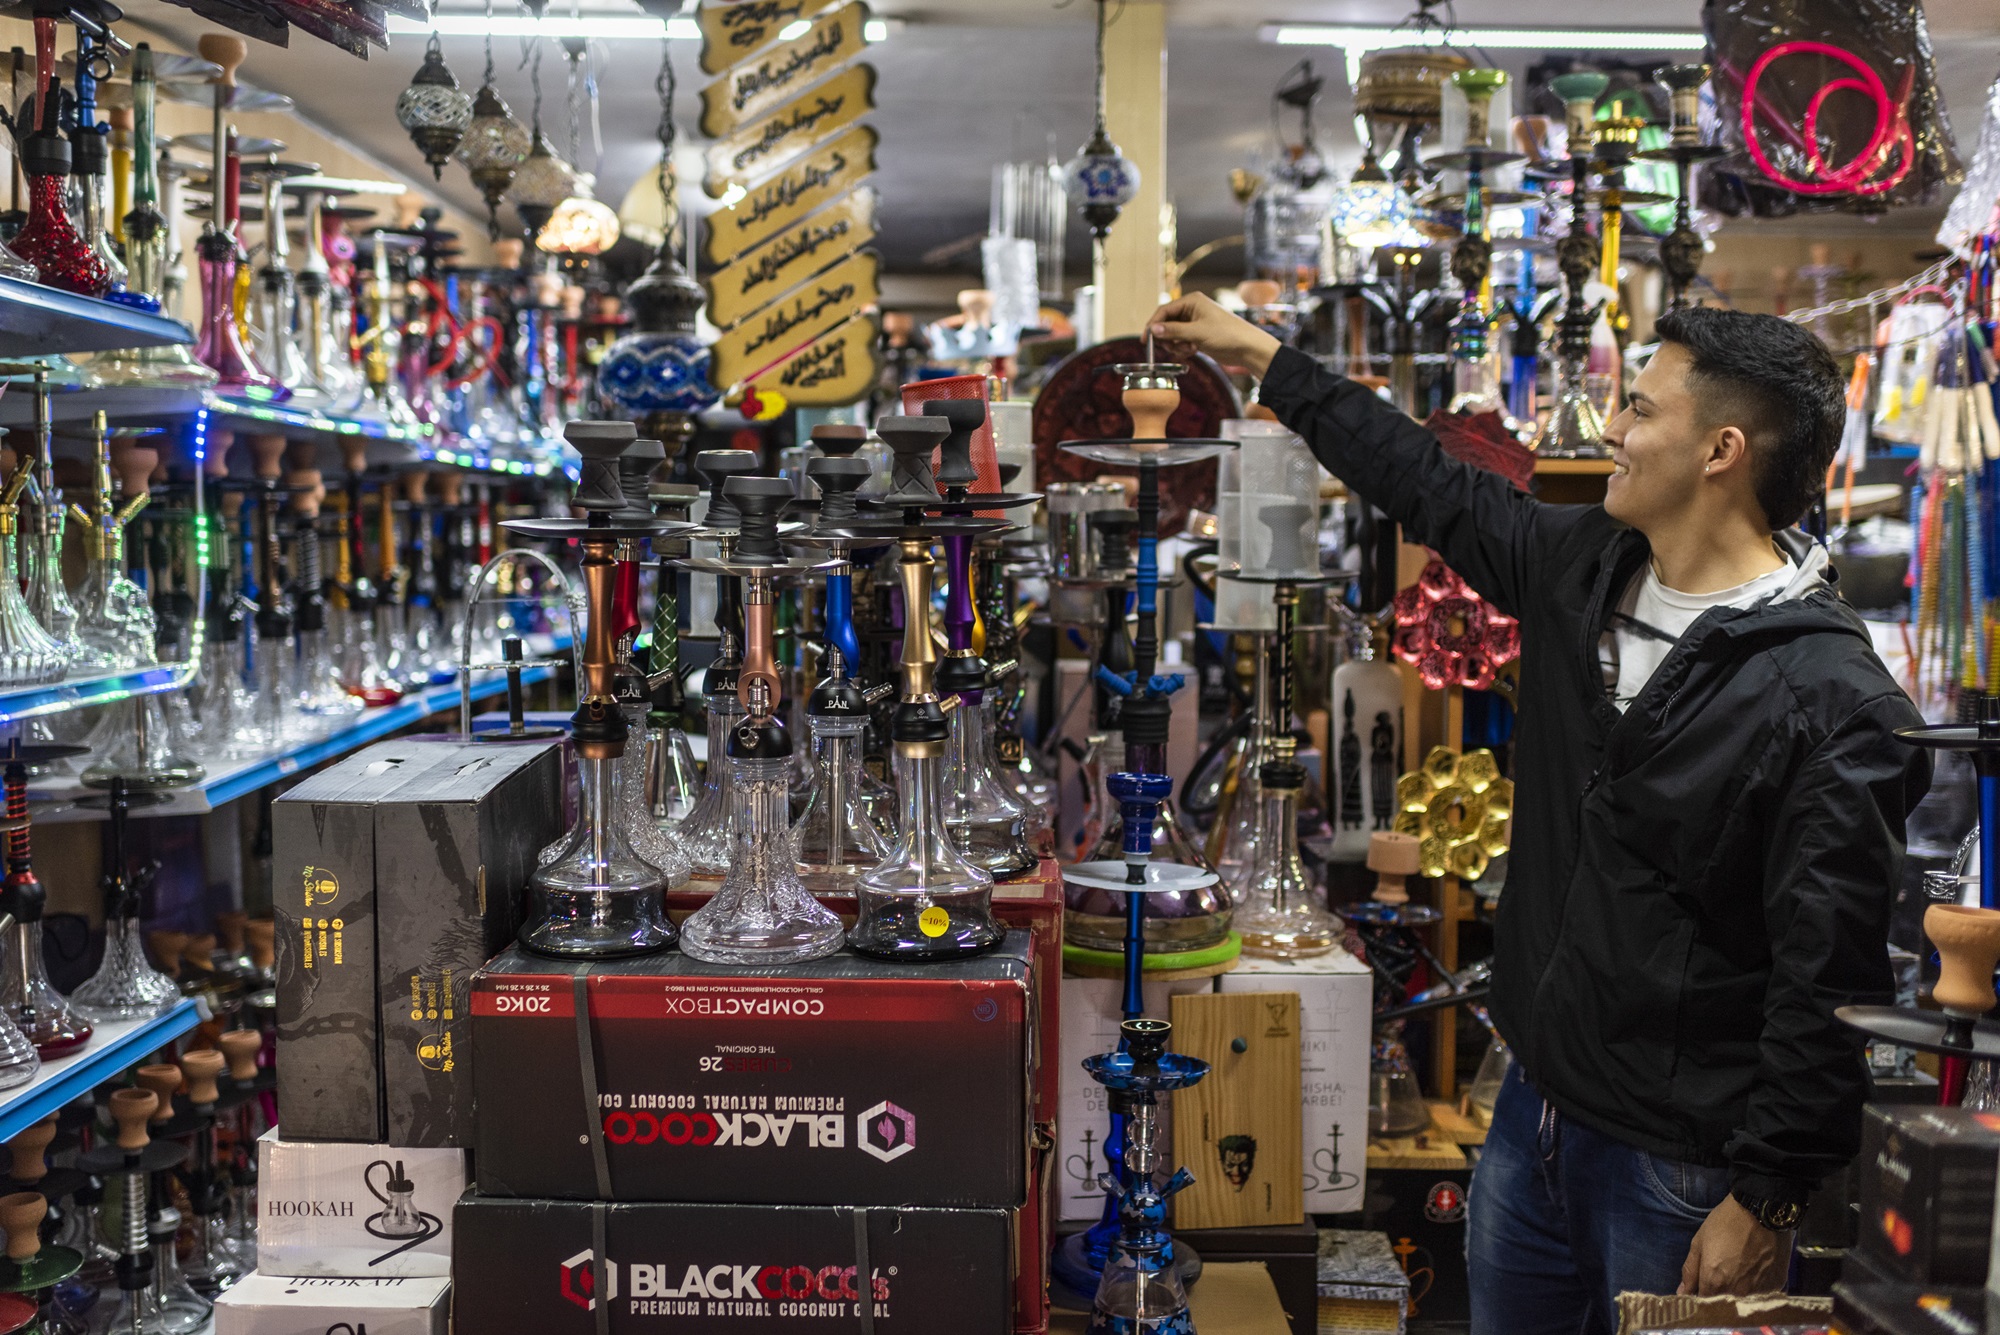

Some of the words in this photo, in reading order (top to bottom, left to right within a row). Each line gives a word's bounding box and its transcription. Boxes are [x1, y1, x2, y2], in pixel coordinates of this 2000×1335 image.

[825, 695, 849, 709] PAN
[922, 916, 947, 927] -10%
[525, 984, 535, 992] 26
[540, 984, 550, 992] 26
[496, 996, 551, 1013] 20KG
[666, 998, 824, 1016] COMPACTBOX
[715, 1045, 757, 1054] ORIGINAL
[758, 1045, 776, 1054] THE
[1301, 1082, 1346, 1094] HISHA,
[630, 1094, 696, 1110] COCONUT
[703, 1095, 767, 1110] NATURAL
[775, 1096, 845, 1112] PREMIUM
[602, 1111, 845, 1148] BLACKCOCO
[268, 1200, 354, 1217] HOOKAH
[630, 1300, 700, 1316] PREMIUM
[707, 1302, 772, 1316] NATURAL
[779, 1302, 846, 1318] COCONUT
[853, 1303, 890, 1318] CAL
